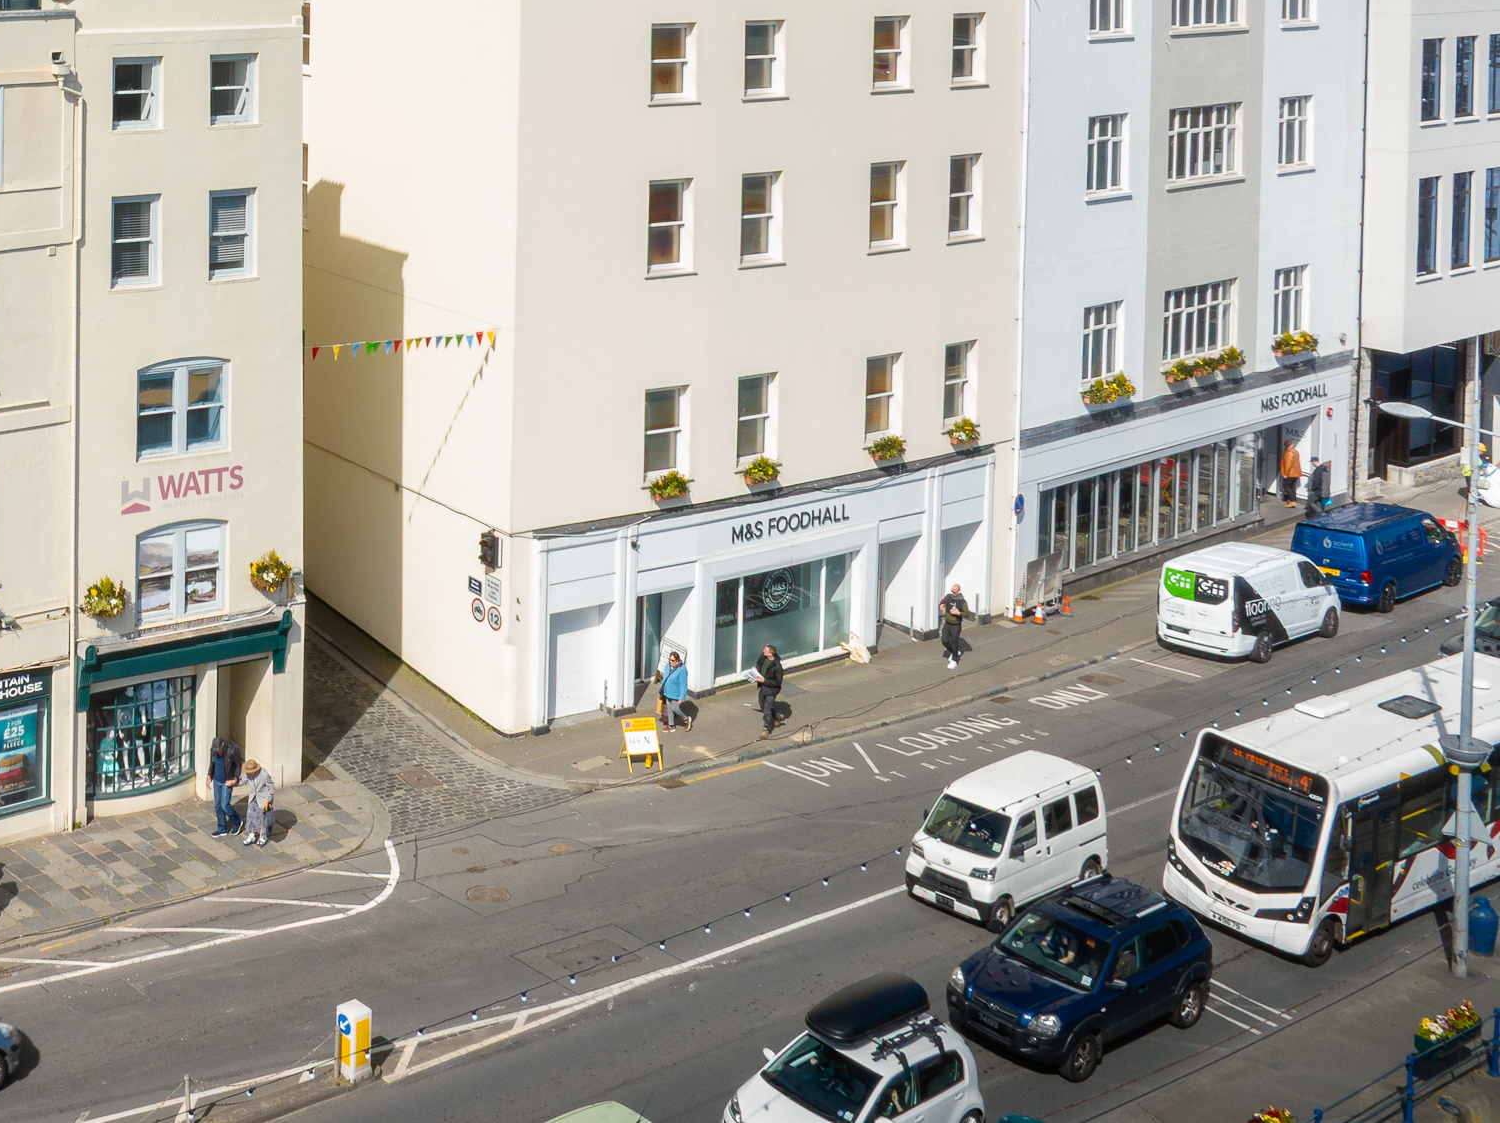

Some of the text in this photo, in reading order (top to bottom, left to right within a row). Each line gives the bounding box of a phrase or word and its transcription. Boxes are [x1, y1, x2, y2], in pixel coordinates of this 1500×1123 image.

[1261, 383, 1328, 413] M&S FOODHALL
[1285, 427, 1306, 439] M&S
[157, 465, 244, 501] WATTS
[161, 491, 244, 510] PROPERTY CONSULTANTS
[732, 503, 850, 544] M&S FOODHALL
[1333, 540, 1354, 548] solent
[771, 582, 786, 592] M&S
[1245, 596, 1281, 617] flooring
[490, 612, 500, 626] 12
[11, 719, 23, 727] FOR
[787, 756, 855, 778] UN
[876, 713, 1021, 756] LOADING
[1028, 683, 1110, 710] ONLY
[3, 725, 25, 740] £25
[3, 739, 24, 750] FLEECE
[921, 755, 967, 770] ALL
[1202, 856, 1230, 877] buses.gg
[1412, 871, 1445, 891] celebrate
